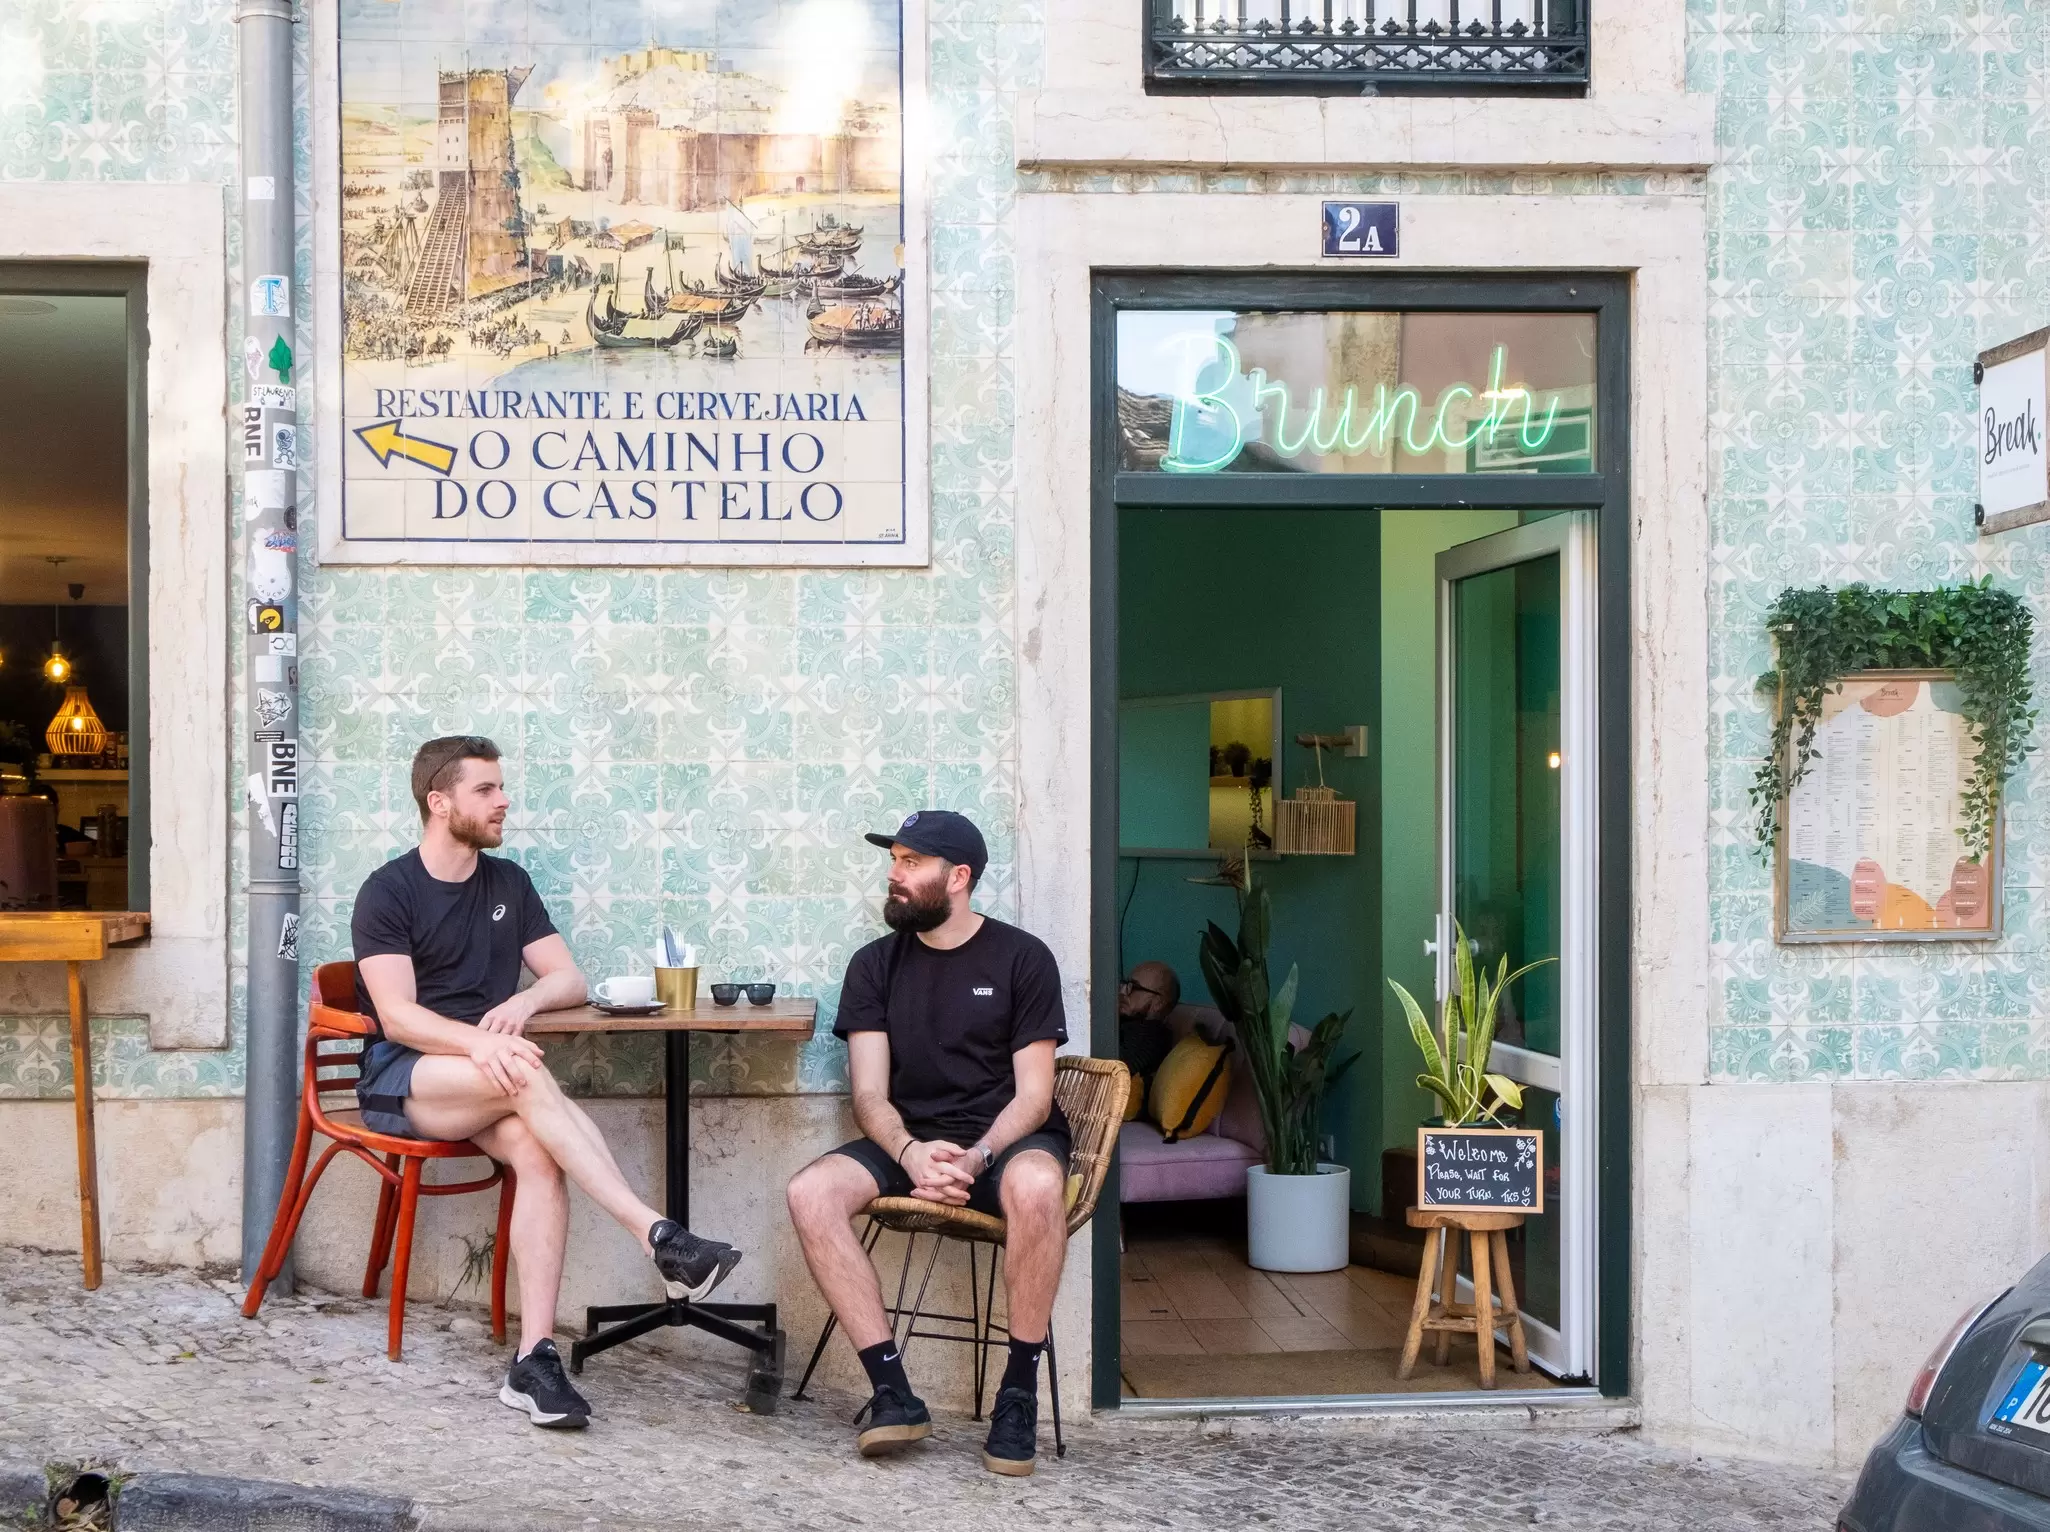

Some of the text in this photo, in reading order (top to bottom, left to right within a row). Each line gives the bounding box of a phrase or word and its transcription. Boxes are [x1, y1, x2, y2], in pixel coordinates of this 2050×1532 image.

[1338, 206, 1383, 251] 2A
[375, 388, 868, 421] RESTAURANTE E CERVEJARIA
[1159, 332, 1559, 470] Brunch
[469, 430, 824, 474] O CAMINHO
[432, 478, 843, 522] DO CASTELO
[272, 743, 296, 793] BNE
[973, 988, 994, 996] VANS
